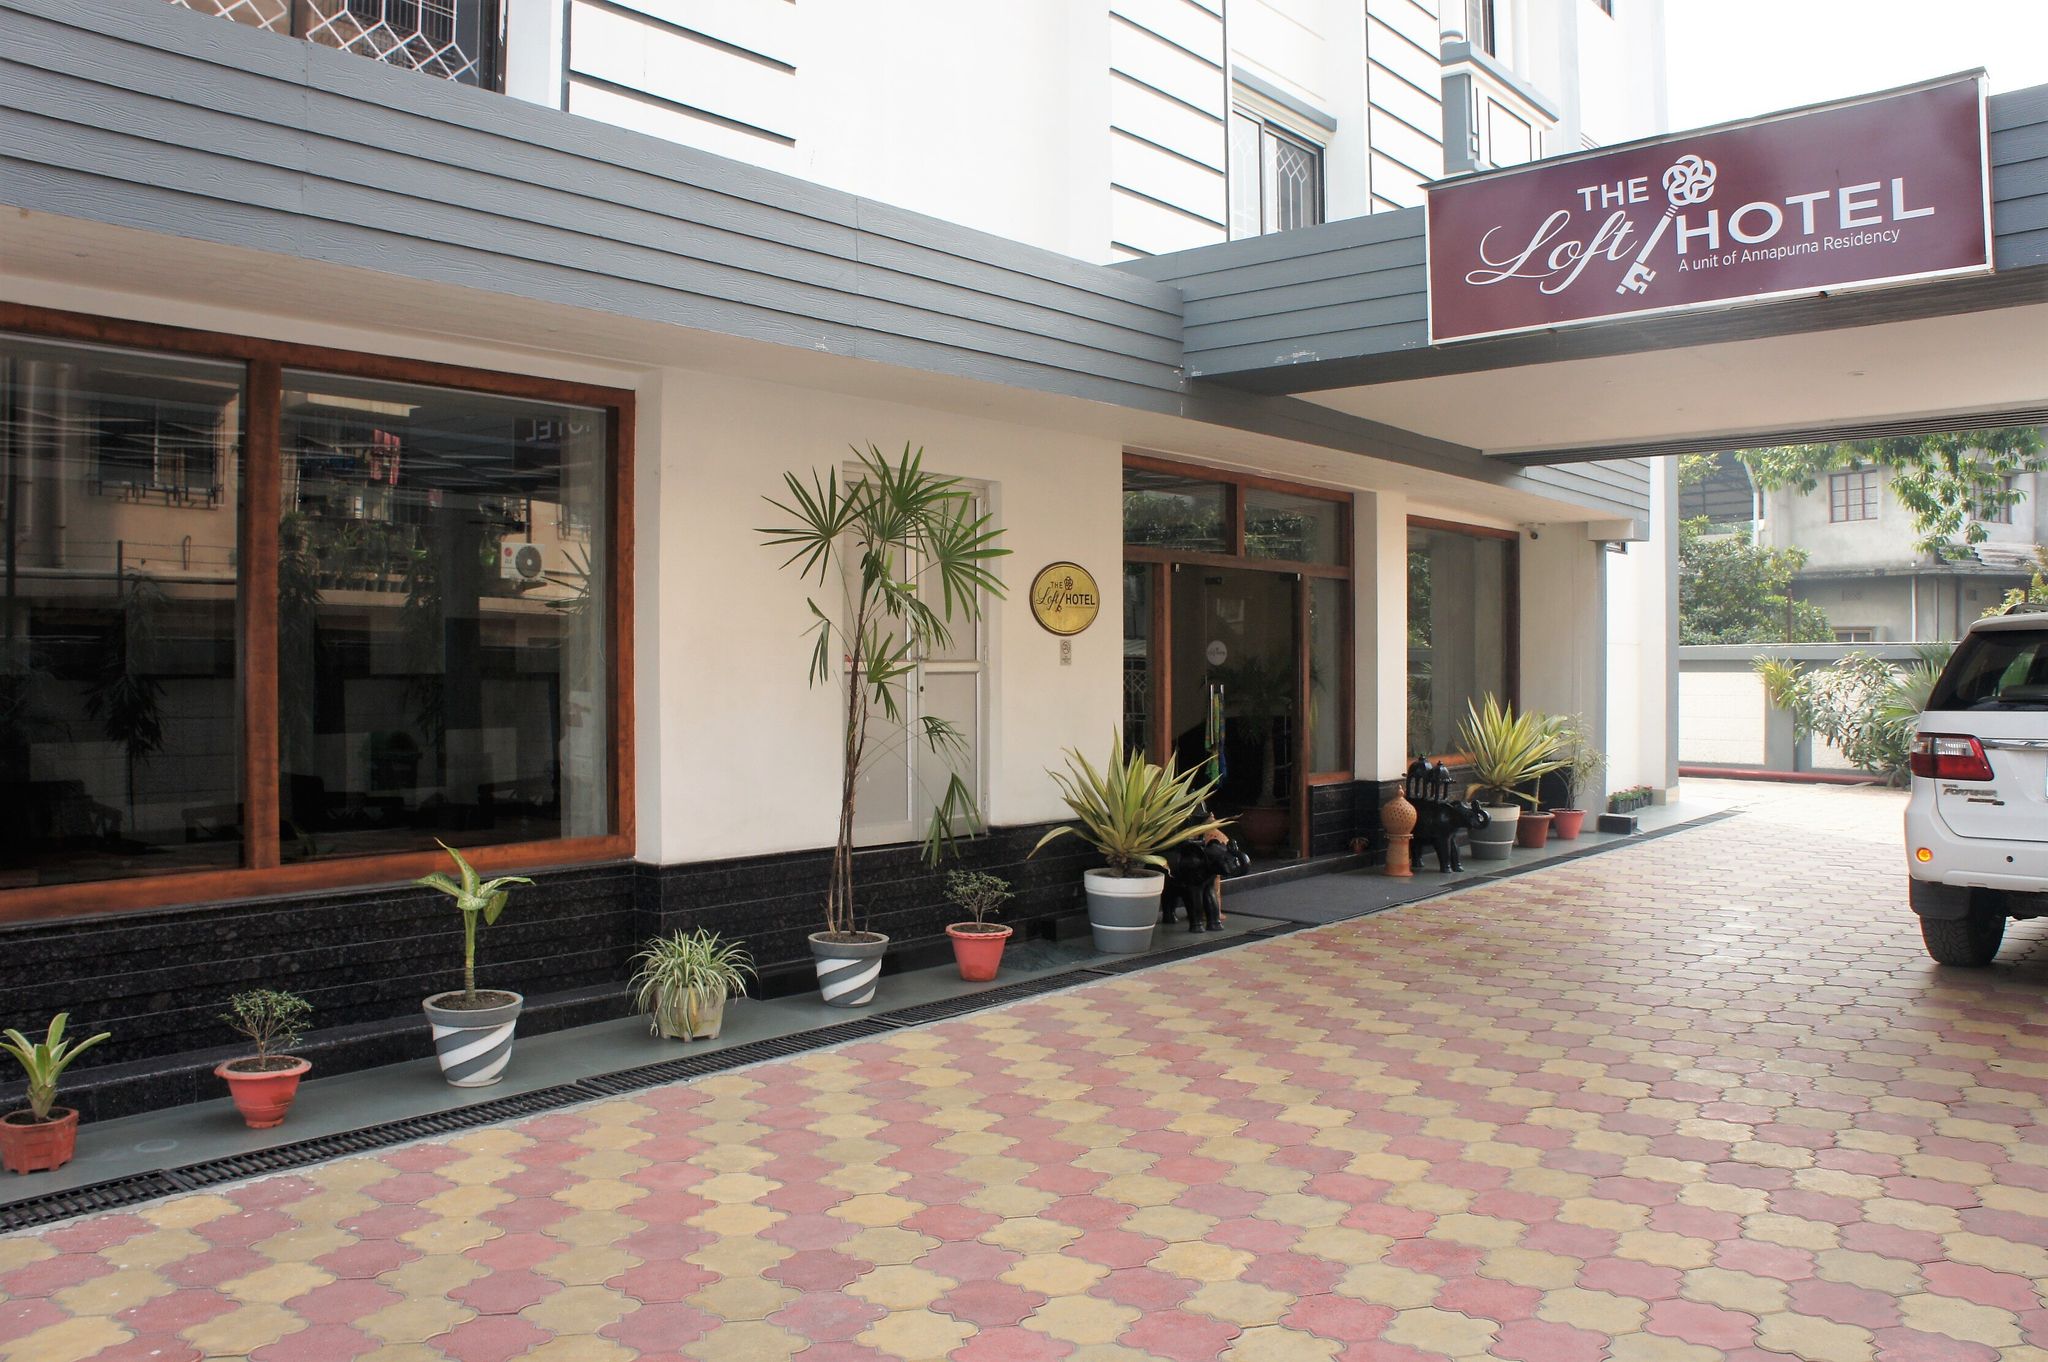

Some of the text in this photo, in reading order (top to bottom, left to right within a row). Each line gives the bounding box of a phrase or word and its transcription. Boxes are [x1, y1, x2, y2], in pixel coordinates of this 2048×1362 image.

[1577, 176, 1649, 211] THE
[1465, 177, 1935, 294] Loft HOTEL
[1678, 228, 1900, 272] A unit of Annapurna Residency
[1050, 581, 1063, 589] THE
[1066, 593, 1095, 605] HOTEL
